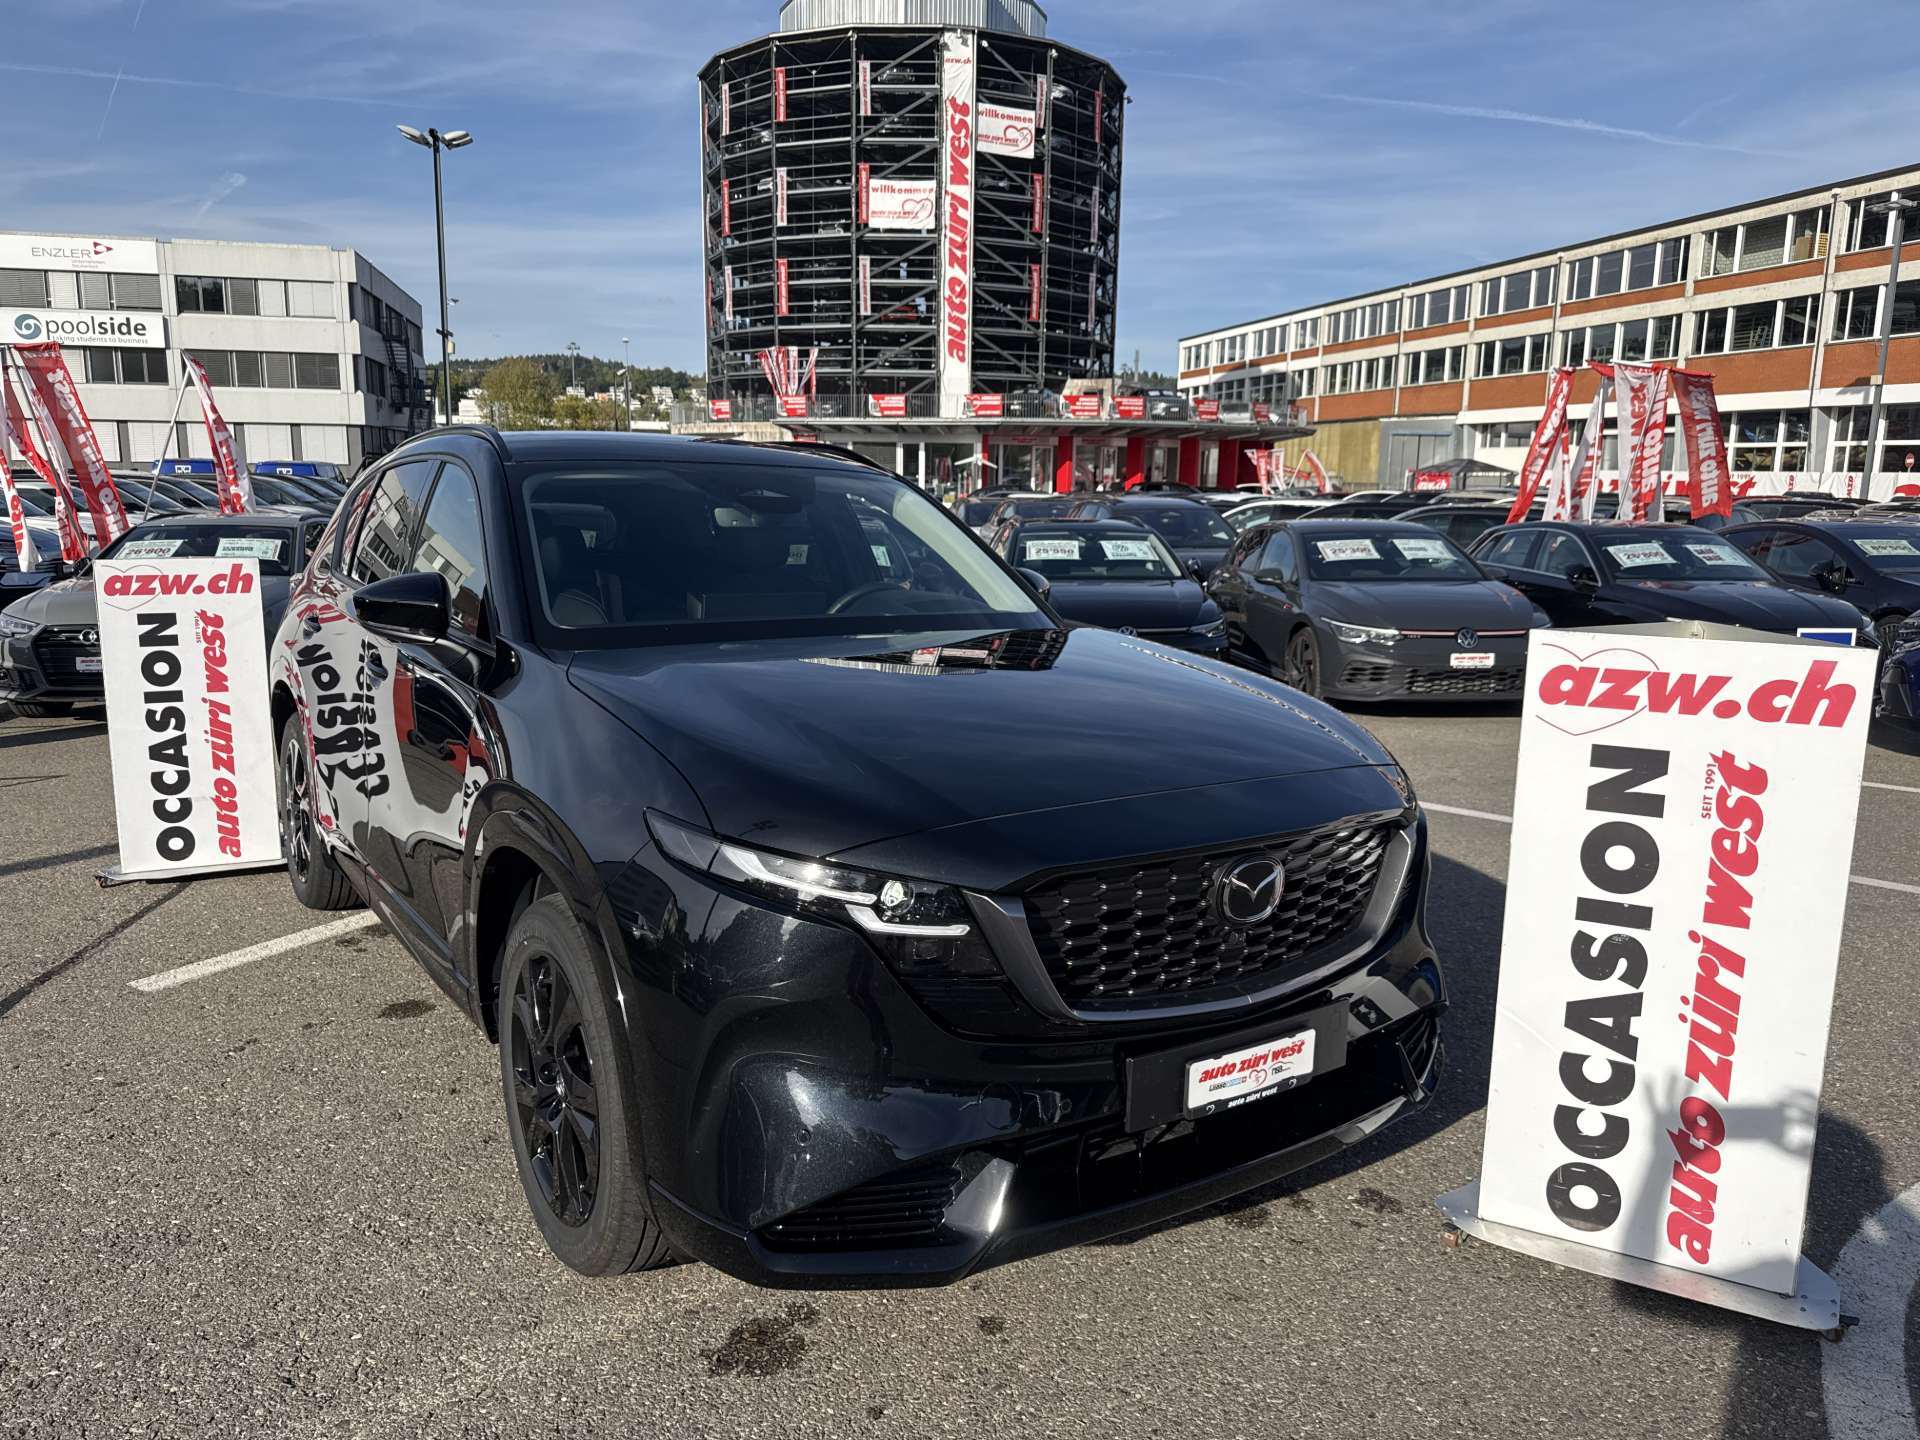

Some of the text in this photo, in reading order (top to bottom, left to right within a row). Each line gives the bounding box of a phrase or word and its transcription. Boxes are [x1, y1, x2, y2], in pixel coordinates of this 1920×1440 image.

[977, 107, 1034, 124] willkommen
[947, 96, 971, 186] west
[871, 184, 935, 195] willkommen
[31, 246, 92, 259] ENZLER
[45, 315, 147, 340] poolside
[77, 335, 108, 344] students
[109, 336, 117, 344] to
[117, 336, 149, 345] business
[943, 276, 967, 364] auto
[103, 563, 253, 597] azw.ch
[1538, 659, 1857, 728] azw.ch
[136, 612, 196, 862] OCCASION
[196, 609, 242, 858] auto züri west
[1701, 763, 1717, 819] SEIT 1991
[1546, 743, 1671, 1232] OCCASION
[1667, 751, 1768, 1265] auto züri west
[1198, 1061, 1237, 1084] auto
[1238, 1049, 1270, 1073] züri
[1270, 1039, 1305, 1062] west
[1227, 1096, 1245, 1108] auto
[1261, 1086, 1279, 1098] west
